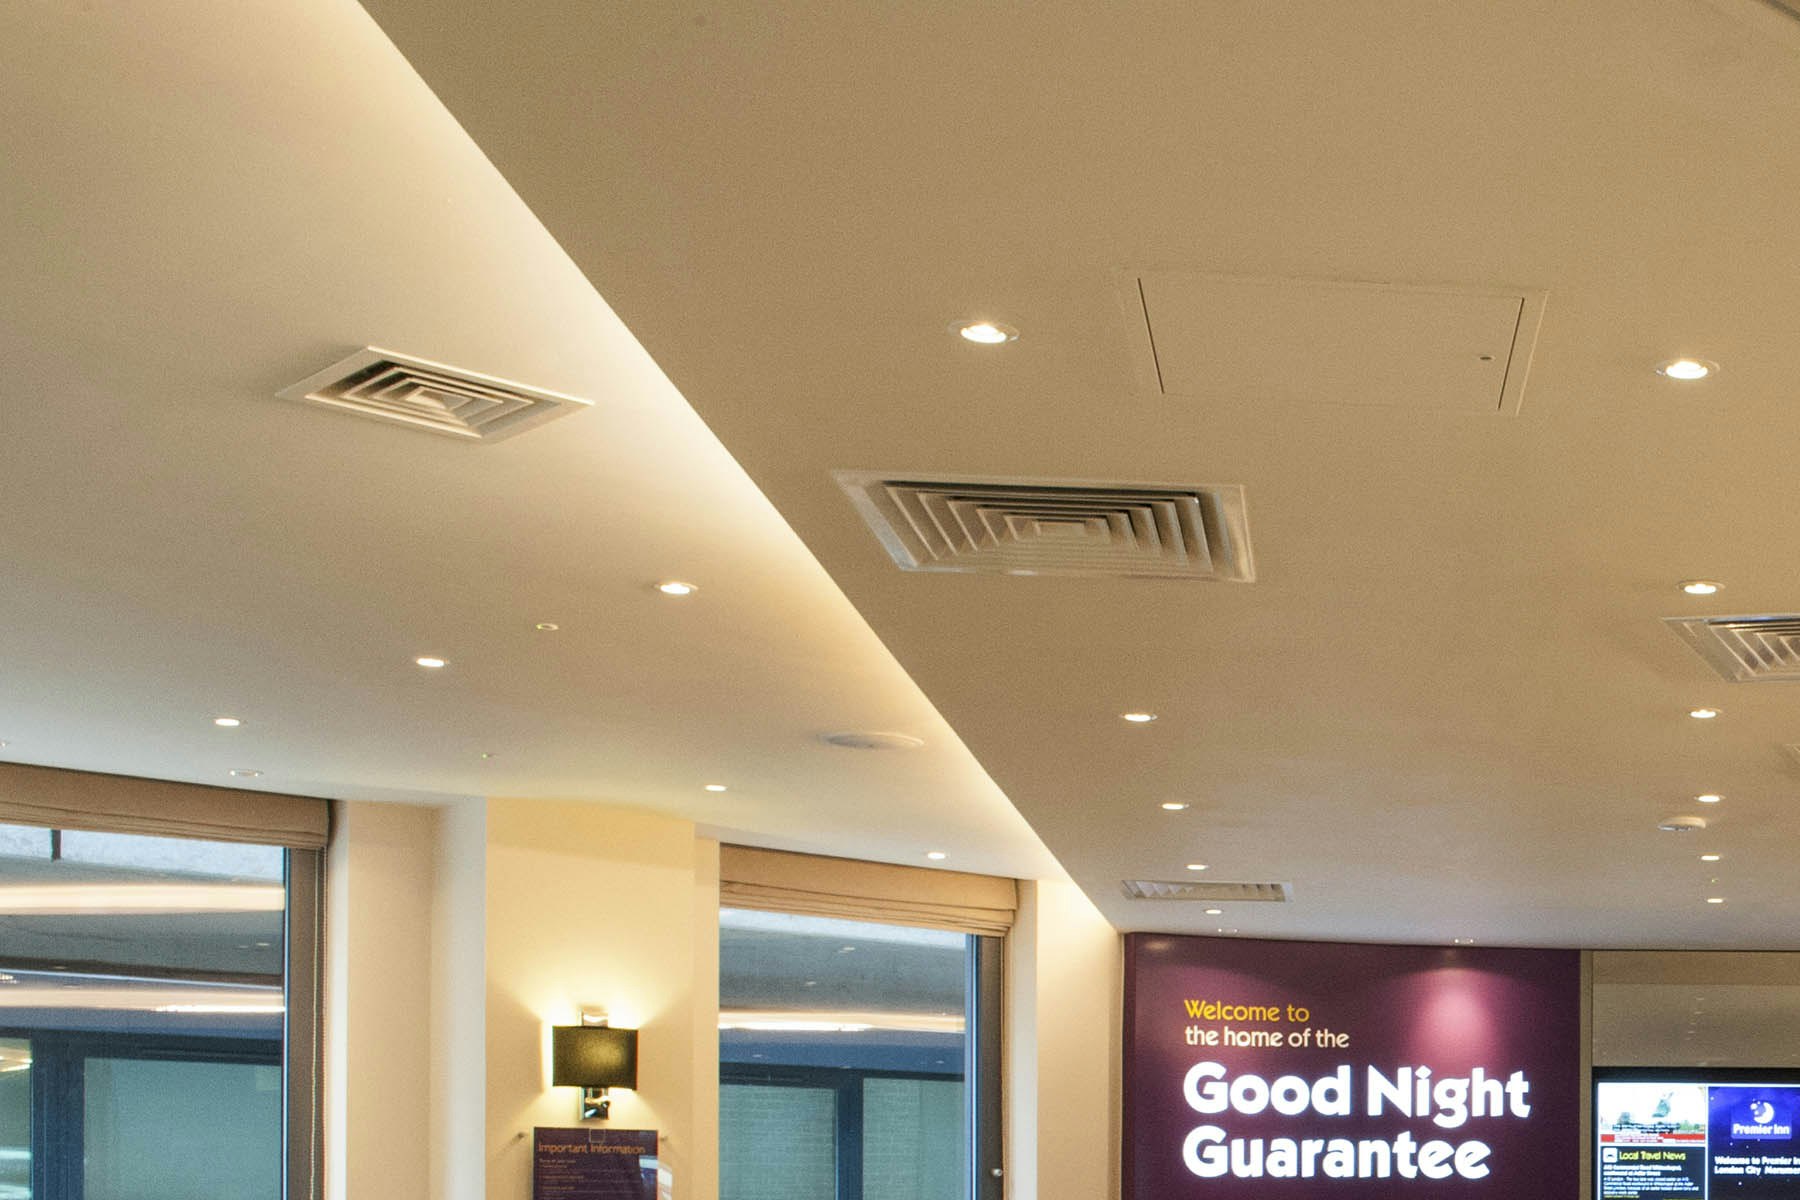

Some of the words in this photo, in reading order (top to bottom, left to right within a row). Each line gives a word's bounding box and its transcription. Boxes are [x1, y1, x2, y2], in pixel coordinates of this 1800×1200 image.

[1184, 1000, 1280, 1022] Welcome
[1287, 1003, 1310, 1023] to
[1185, 1026, 1219, 1047] the
[1223, 1027, 1283, 1048] home
[1288, 1028, 1311, 1048] of
[1315, 1028, 1350, 1048] the
[1183, 1061, 1351, 1116] Good
[1367, 1065, 1532, 1129] Night
[1733, 1123, 1772, 1135] Premier
[1773, 1123, 1790, 1135] Inn
[538, 1142, 588, 1154] Important
[590, 1144, 646, 1155] Information
[1182, 1125, 1491, 1180] Guarantee
[1619, 1151, 1639, 1161] Local
[1641, 1151, 1661, 1161] Travel
[1663, 1151, 1686, 1161] News
[1714, 1156, 1750, 1165] Welcome
[1751, 1156, 1761, 1165] to
[1761, 1156, 1792, 1165] Premier
[1714, 1165, 1744, 1174] London
[1745, 1165, 1761, 1176] City
